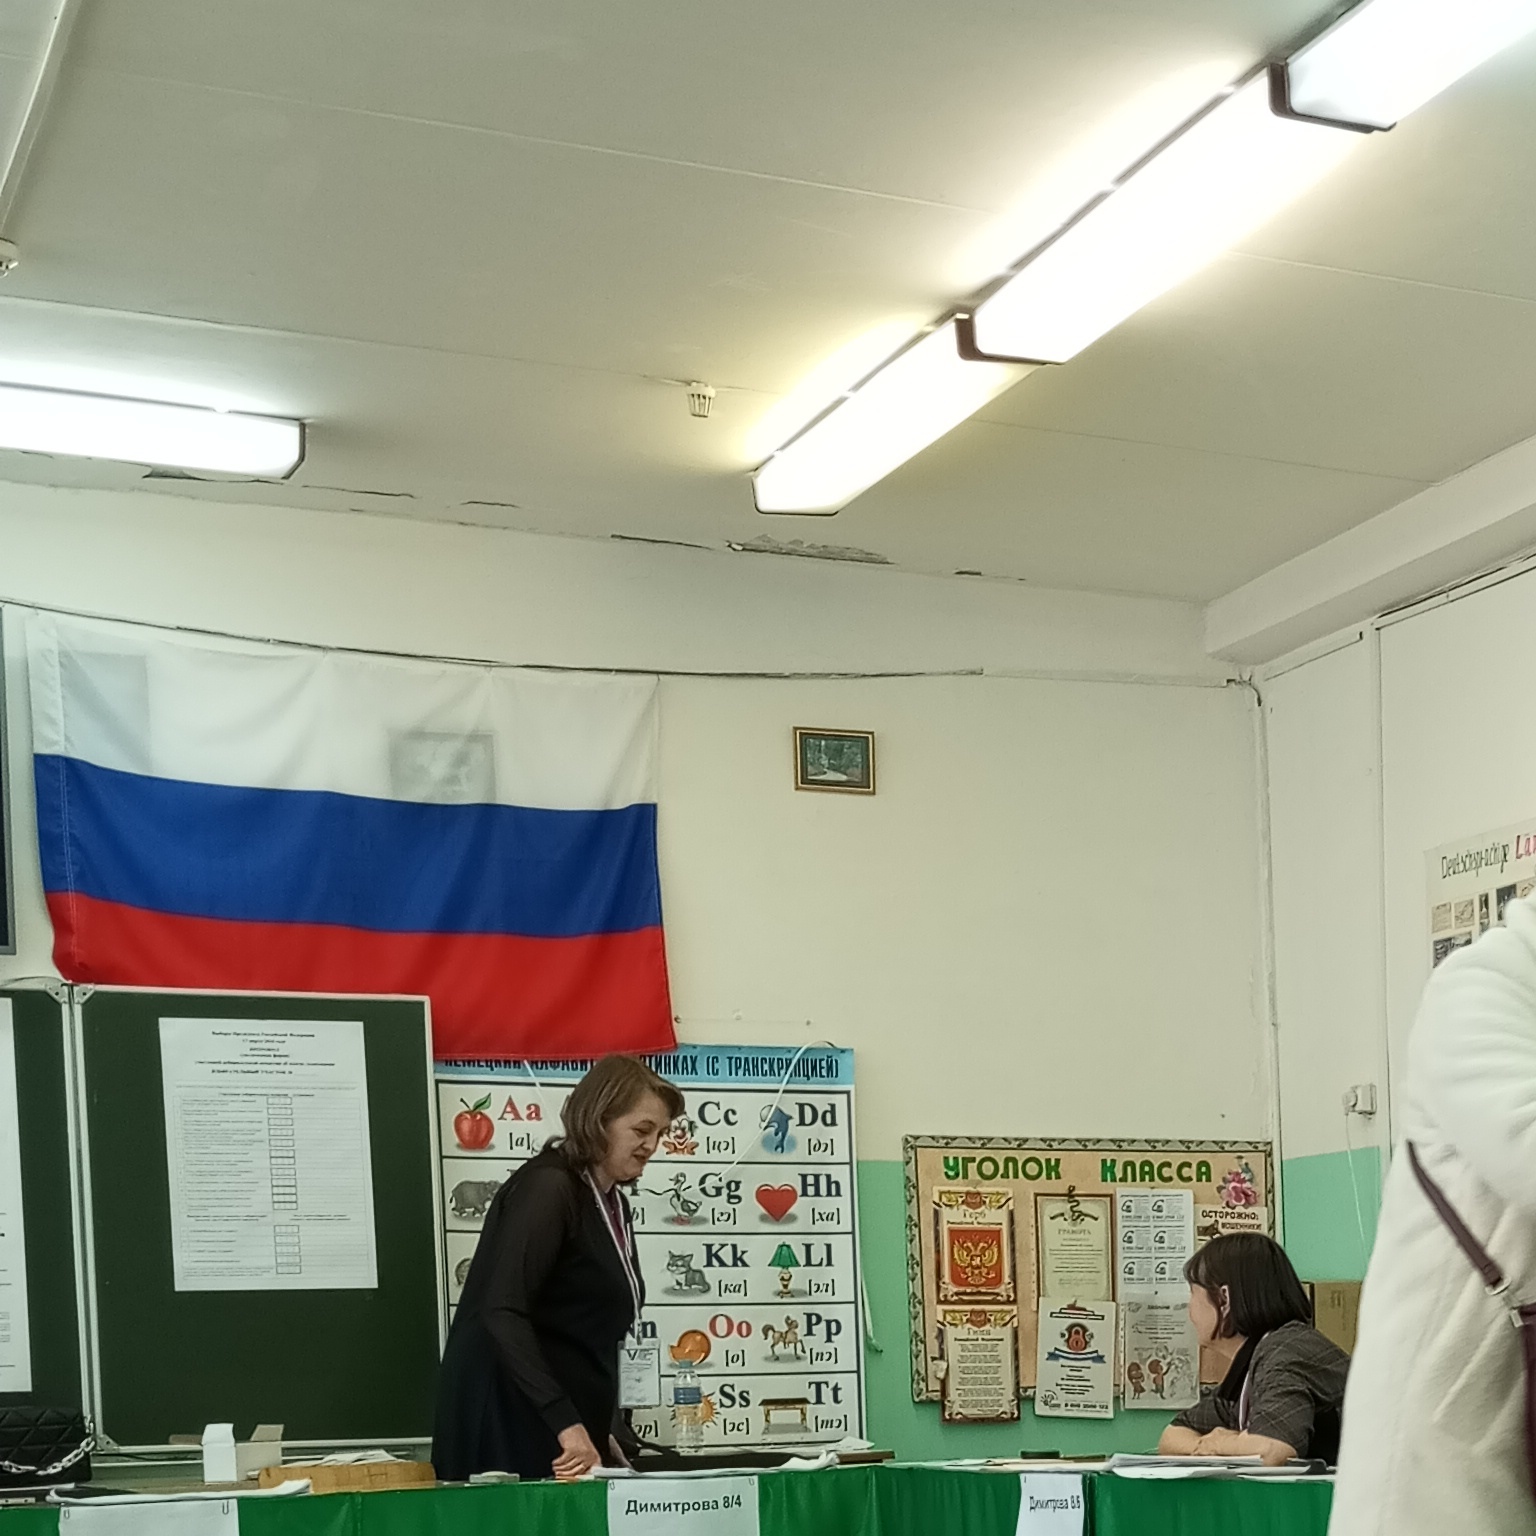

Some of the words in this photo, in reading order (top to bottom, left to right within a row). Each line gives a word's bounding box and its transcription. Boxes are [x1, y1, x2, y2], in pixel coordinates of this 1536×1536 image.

[726, 1055, 840, 1080] ТРАНСКРИПЦИЕЙ)
[498, 1095, 543, 1121] Aa
[698, 1101, 738, 1126] Cc
[795, 1102, 838, 1127] Dd
[943, 1156, 1062, 1181] УГОЛОК
[1101, 1158, 1212, 1183] КЛАССА
[699, 1172, 742, 1205] Gg
[798, 1173, 842, 1197] Hh
[702, 1243, 750, 1267] Kk
[801, 1243, 834, 1267] Ll
[709, 1313, 752, 1338] Oo
[803, 1312, 842, 1343] Pp
[719, 1383, 750, 1408] Ss
[808, 1381, 843, 1405] Tt
[625, 1499, 719, 1515] Димитрова
[722, 1494, 742, 1509] 8/4
